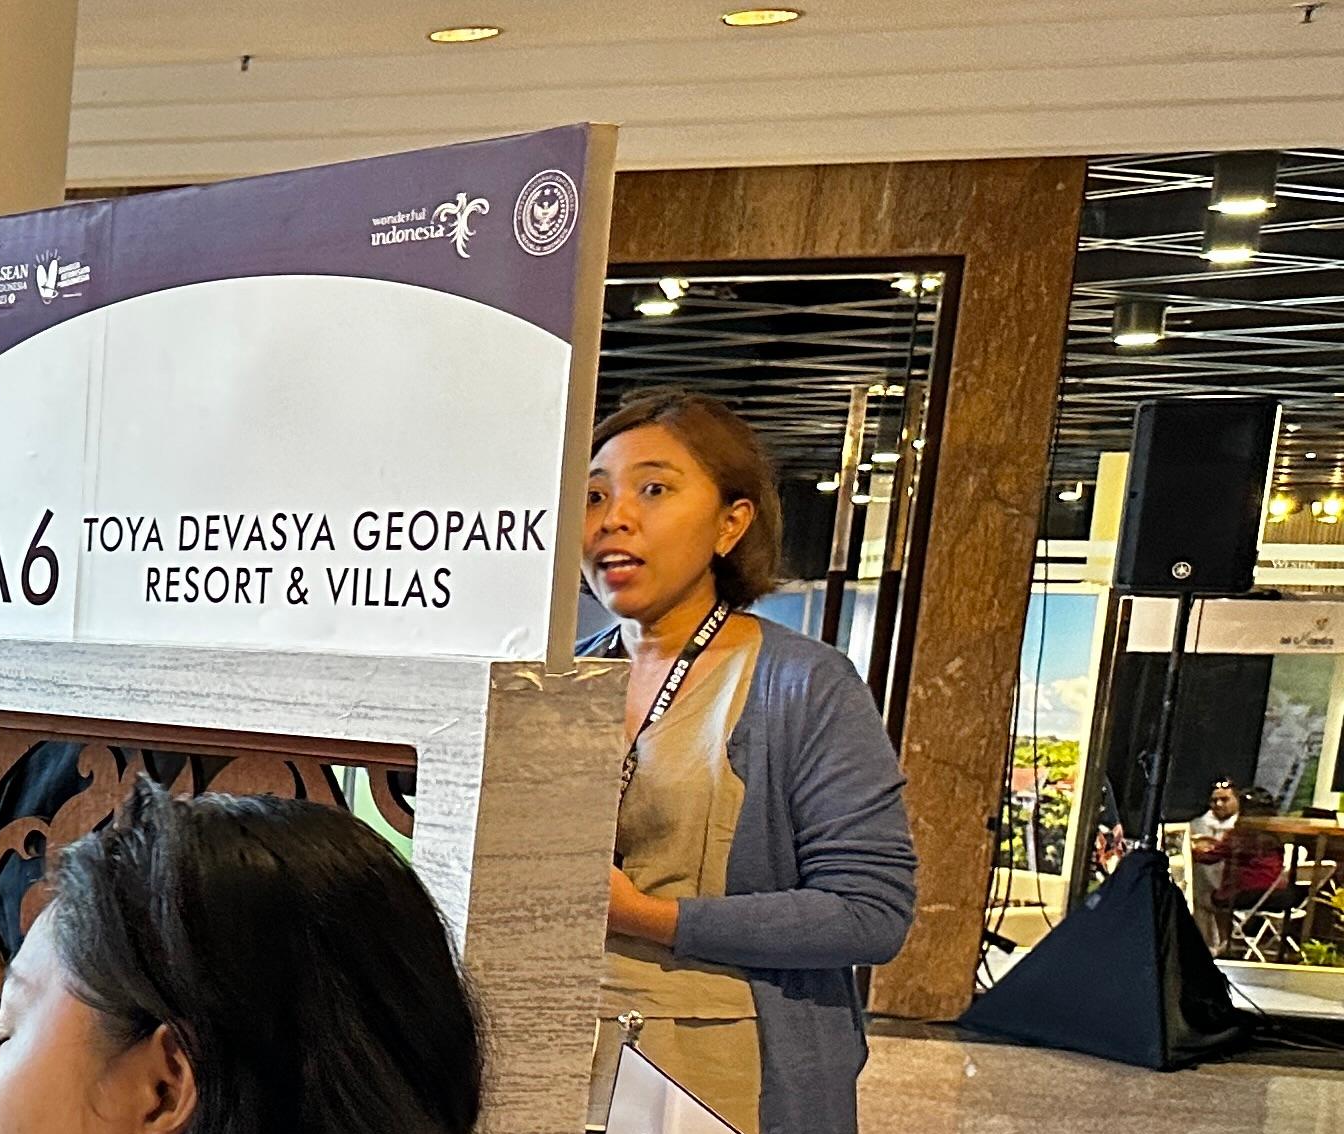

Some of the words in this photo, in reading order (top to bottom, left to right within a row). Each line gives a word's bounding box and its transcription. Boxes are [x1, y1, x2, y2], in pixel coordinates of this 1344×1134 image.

[371, 208, 427, 227] wonderful
[371, 224, 446, 246] indonesia
[83, 516, 164, 553] TOYA
[178, 513, 332, 552] DEVASYA
[352, 509, 548, 551] GEOPARK
[145, 567, 274, 603] RESORT
[286, 566, 310, 604] &
[327, 567, 452, 607] VILLAS
[666, 659, 690, 692] 2023
